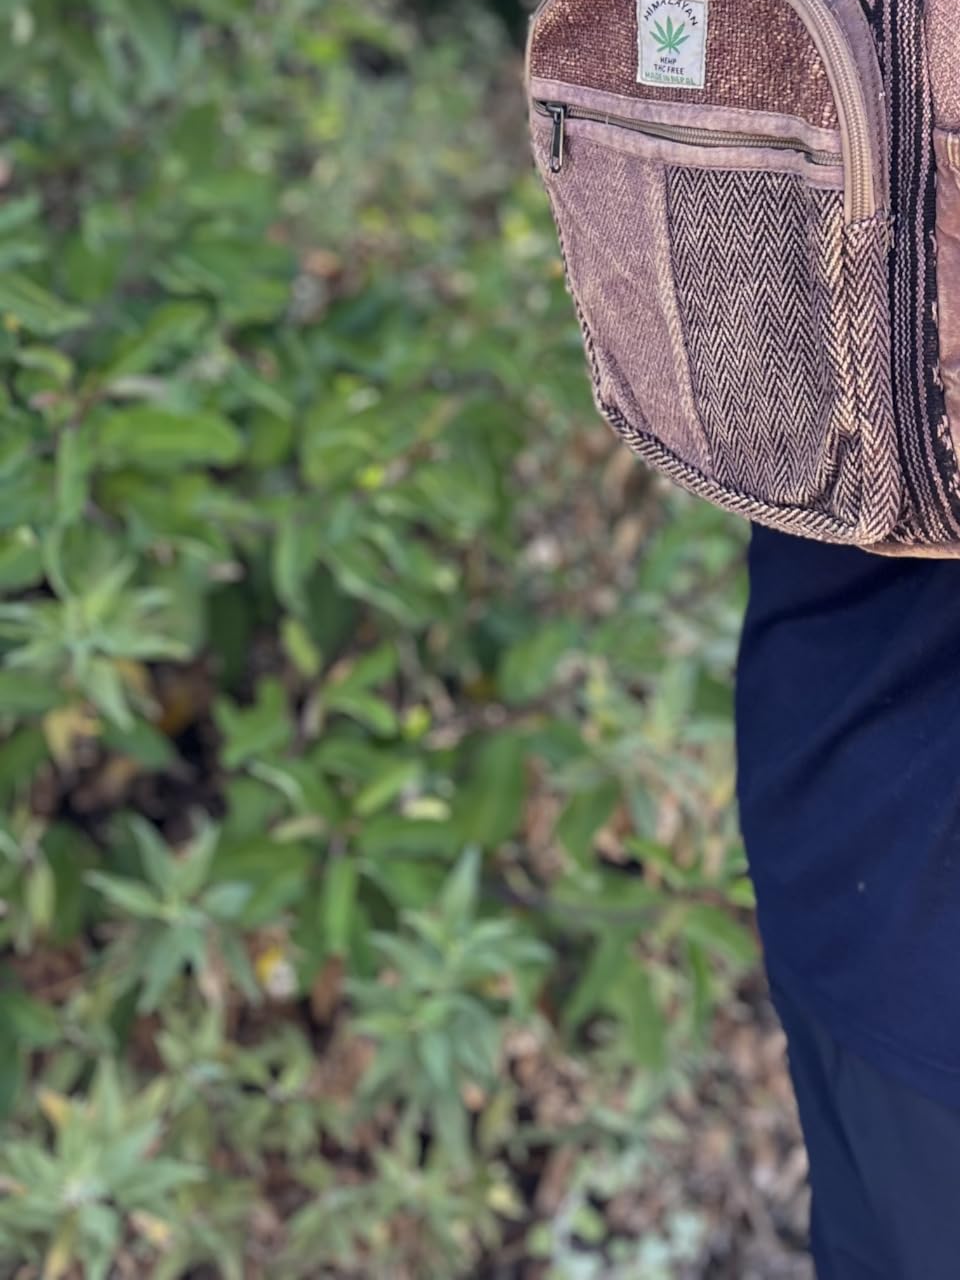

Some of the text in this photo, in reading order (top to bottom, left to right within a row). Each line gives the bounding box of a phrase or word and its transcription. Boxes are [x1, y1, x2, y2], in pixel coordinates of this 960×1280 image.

[660, 56, 677, 65] HEMP
[653, 63, 685, 75] THC FREE
[644, 71, 662, 80] MADE
